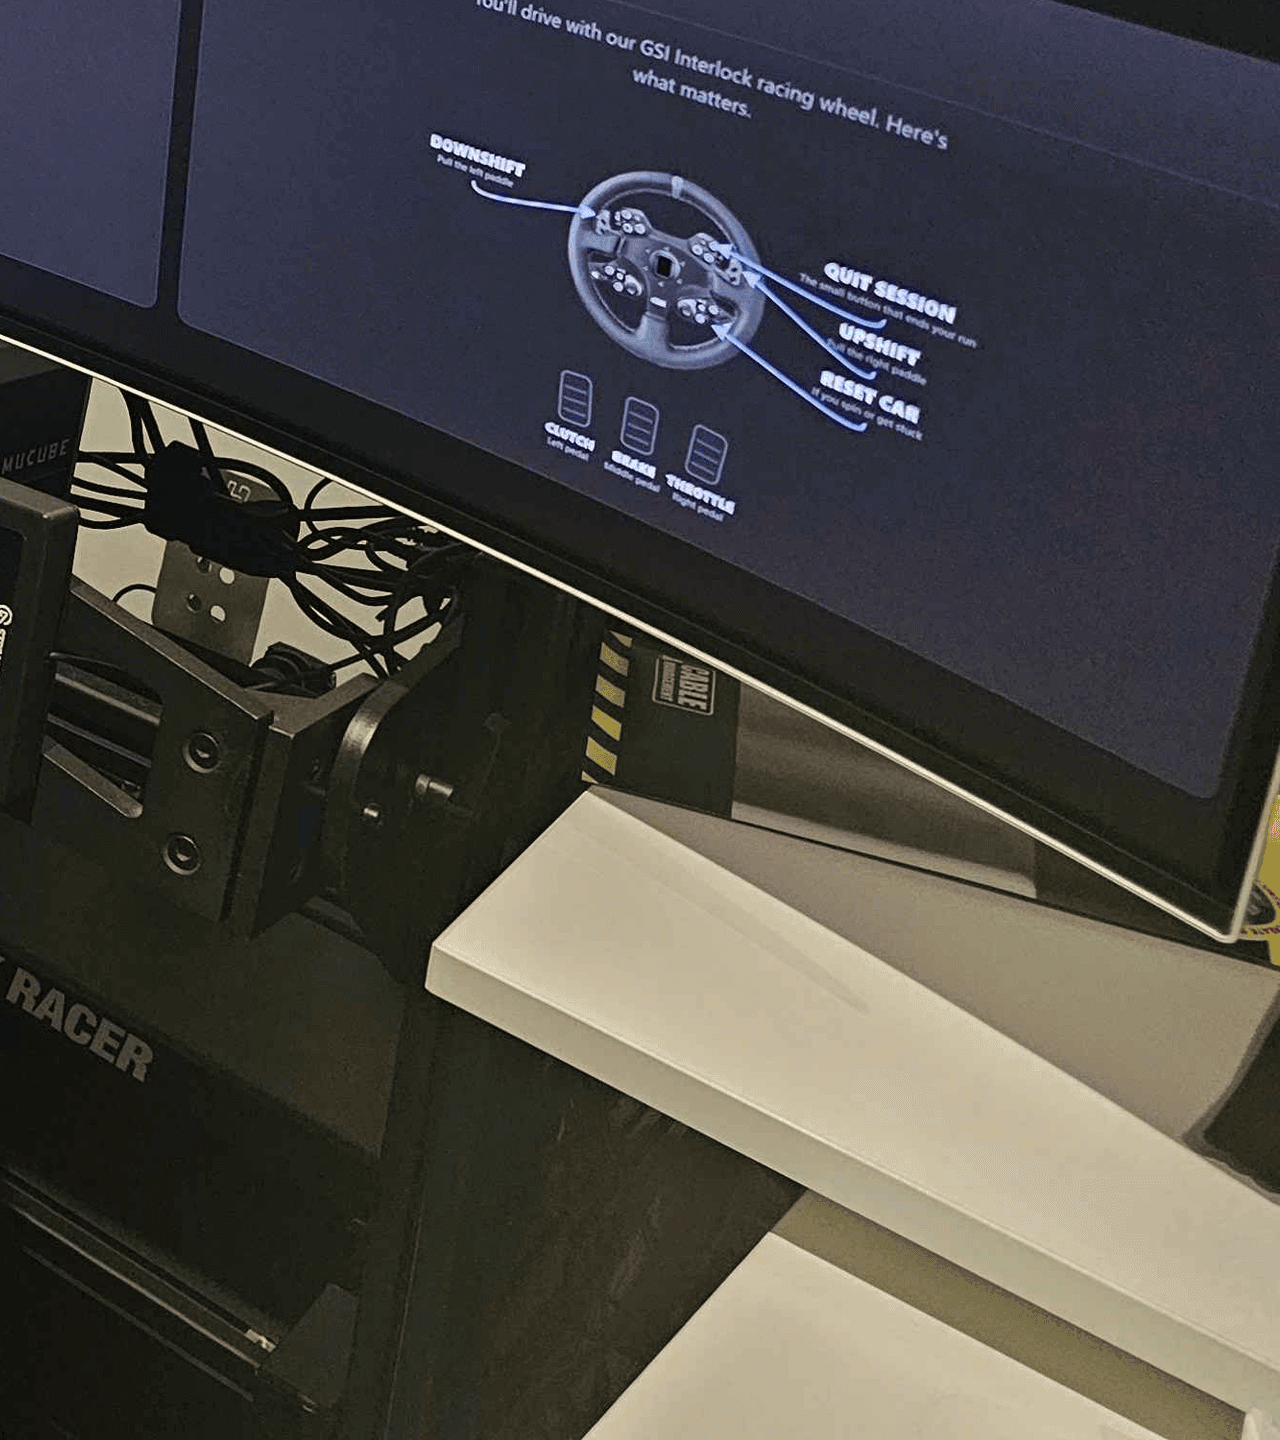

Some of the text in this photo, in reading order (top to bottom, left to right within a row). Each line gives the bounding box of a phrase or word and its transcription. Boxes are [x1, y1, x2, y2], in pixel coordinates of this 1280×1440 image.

[520, 4, 562, 29] drive
[566, 19, 602, 41] with
[605, 33, 637, 51] our
[640, 39, 670, 62] GSI
[674, 47, 753, 88] Interlock
[756, 76, 815, 111] racing
[819, 96, 879, 129] wheel.
[885, 114, 948, 150] Here's
[633, 69, 752, 119] what matters.
[430, 133, 526, 178] DOWNSHIFT
[823, 262, 957, 325] QUIT SESSION
[839, 322, 922, 368] UPSHIFT
[846, 291, 882, 312] button
[957, 336, 977, 349] run
[820, 370, 920, 425] RESET CAR
[544, 421, 596, 452] CLUTCH
[665, 473, 736, 515] THROTTLE
[679, 665, 709, 710] CABLE
[5, 966, 154, 1083] RACER
